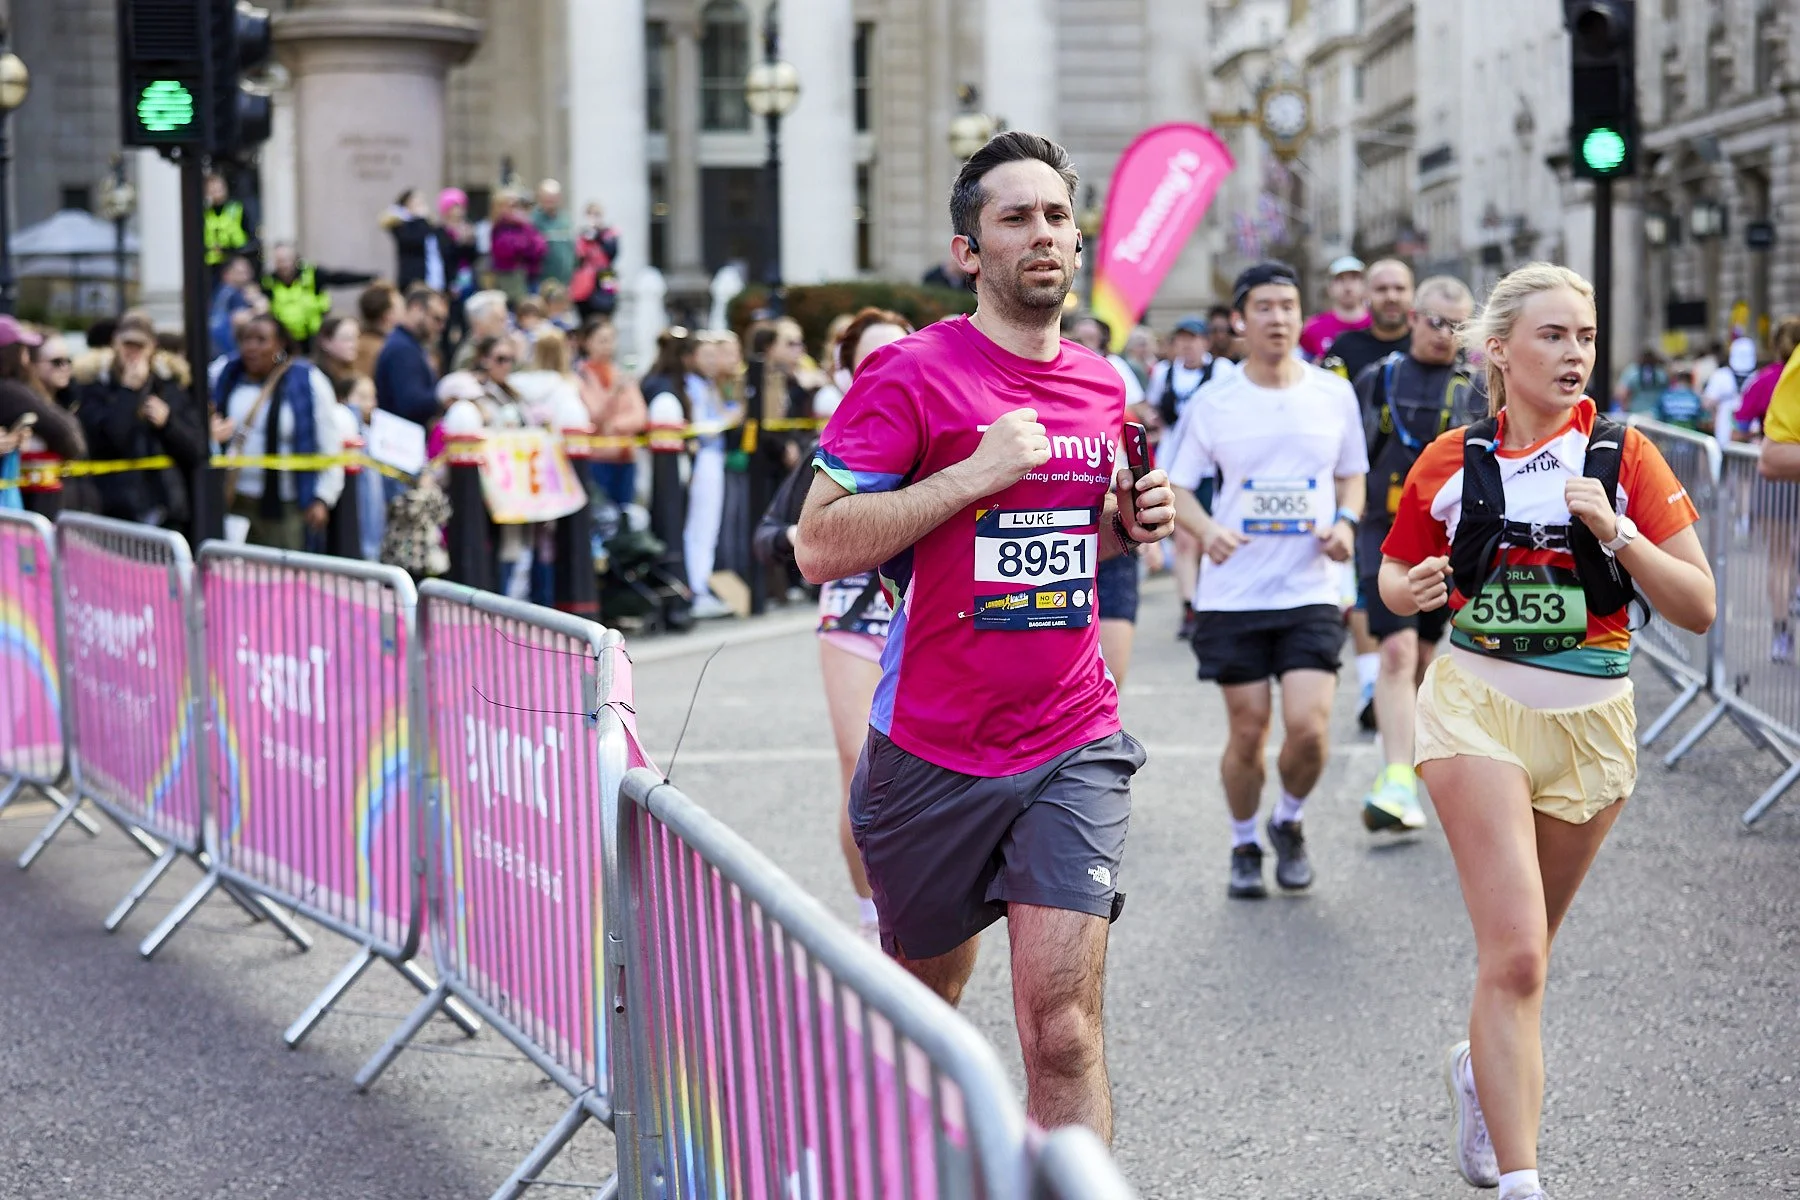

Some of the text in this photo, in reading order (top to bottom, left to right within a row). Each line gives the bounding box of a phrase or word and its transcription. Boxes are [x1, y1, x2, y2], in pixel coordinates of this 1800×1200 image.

[1540, 459, 1560, 471] UK
[1051, 471, 1071, 481] and
[1072, 471, 1094, 484] baby
[1253, 495, 1309, 515] 3065
[1012, 512, 1054, 525] LUKE
[997, 538, 1086, 578] 8951
[1471, 593, 1566, 625] 5953
